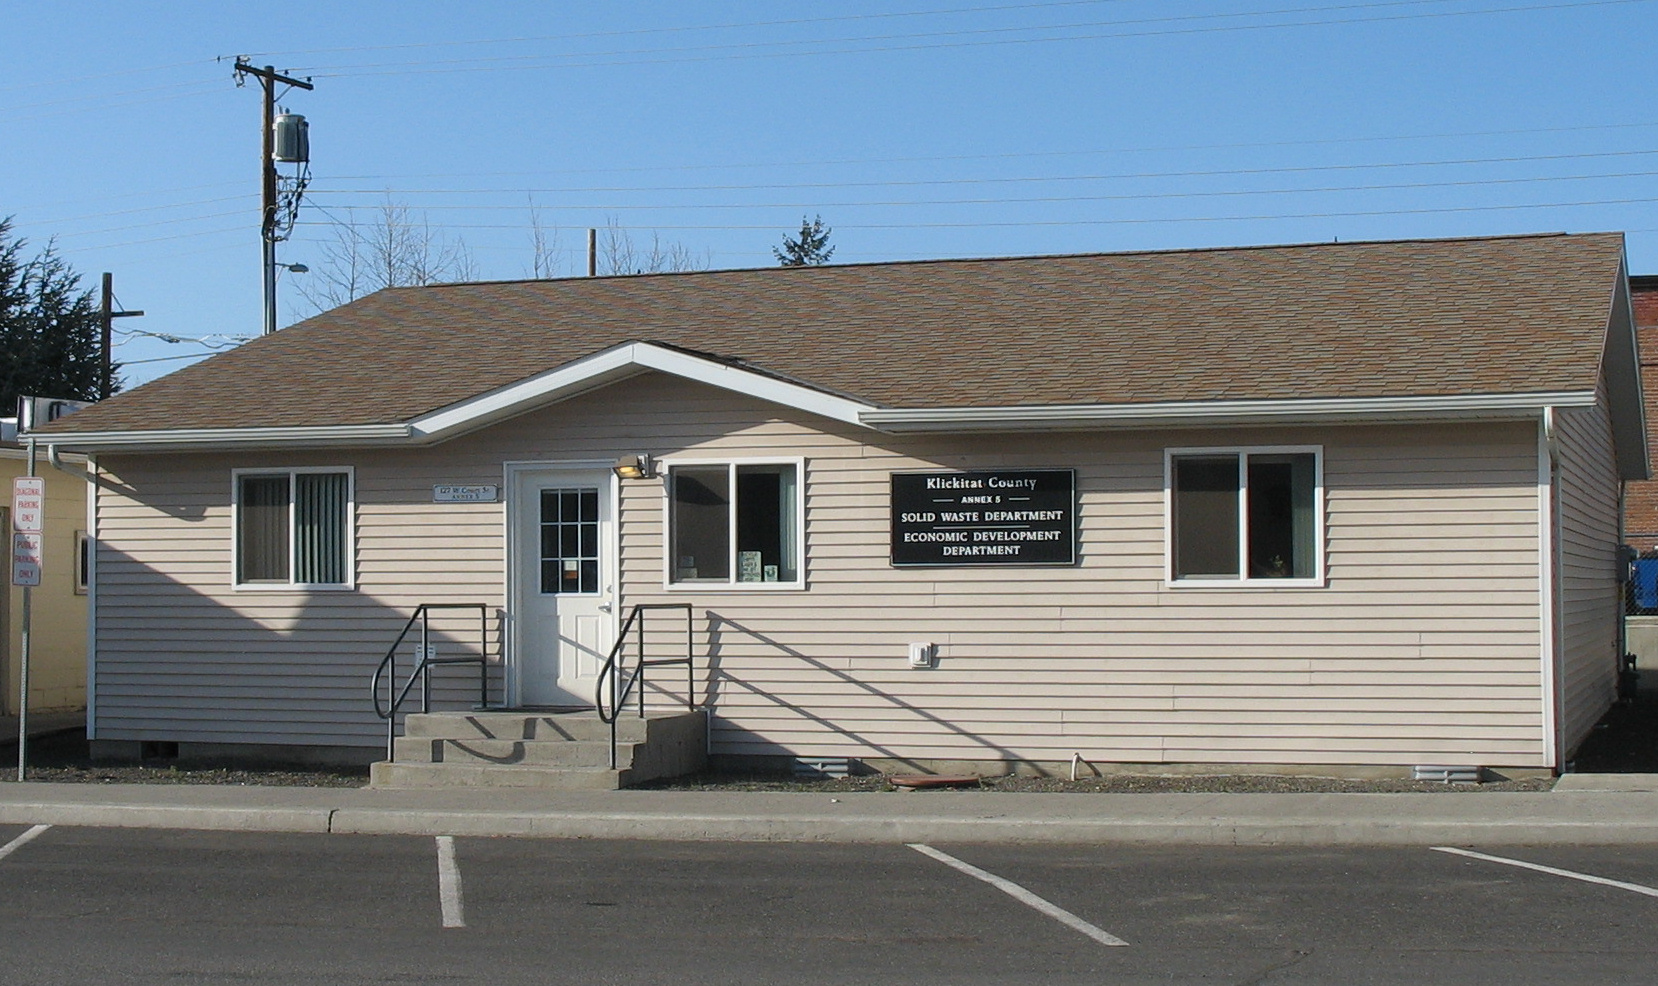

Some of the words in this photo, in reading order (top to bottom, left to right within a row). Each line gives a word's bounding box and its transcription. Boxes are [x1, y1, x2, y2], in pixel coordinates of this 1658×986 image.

[926, 477, 983, 489] Klickitat
[988, 477, 1037, 491] County
[960, 496, 993, 504] ANNEX
[995, 495, 1002, 504] 5
[18, 500, 39, 509] PARKING
[21, 514, 34, 522] ONLY
[901, 512, 936, 523] SOLID
[940, 511, 980, 522] WASTE
[984, 510, 1064, 521] DEPARTMENT
[903, 532, 968, 542] ECONOMIC
[973, 530, 1062, 542] DEVELOPMENT
[16, 541, 39, 549] PUBLIC
[942, 545, 1021, 556] DEPARTMENT
[14, 555, 40, 565] PARKING
[19, 570, 33, 578] ONLY
